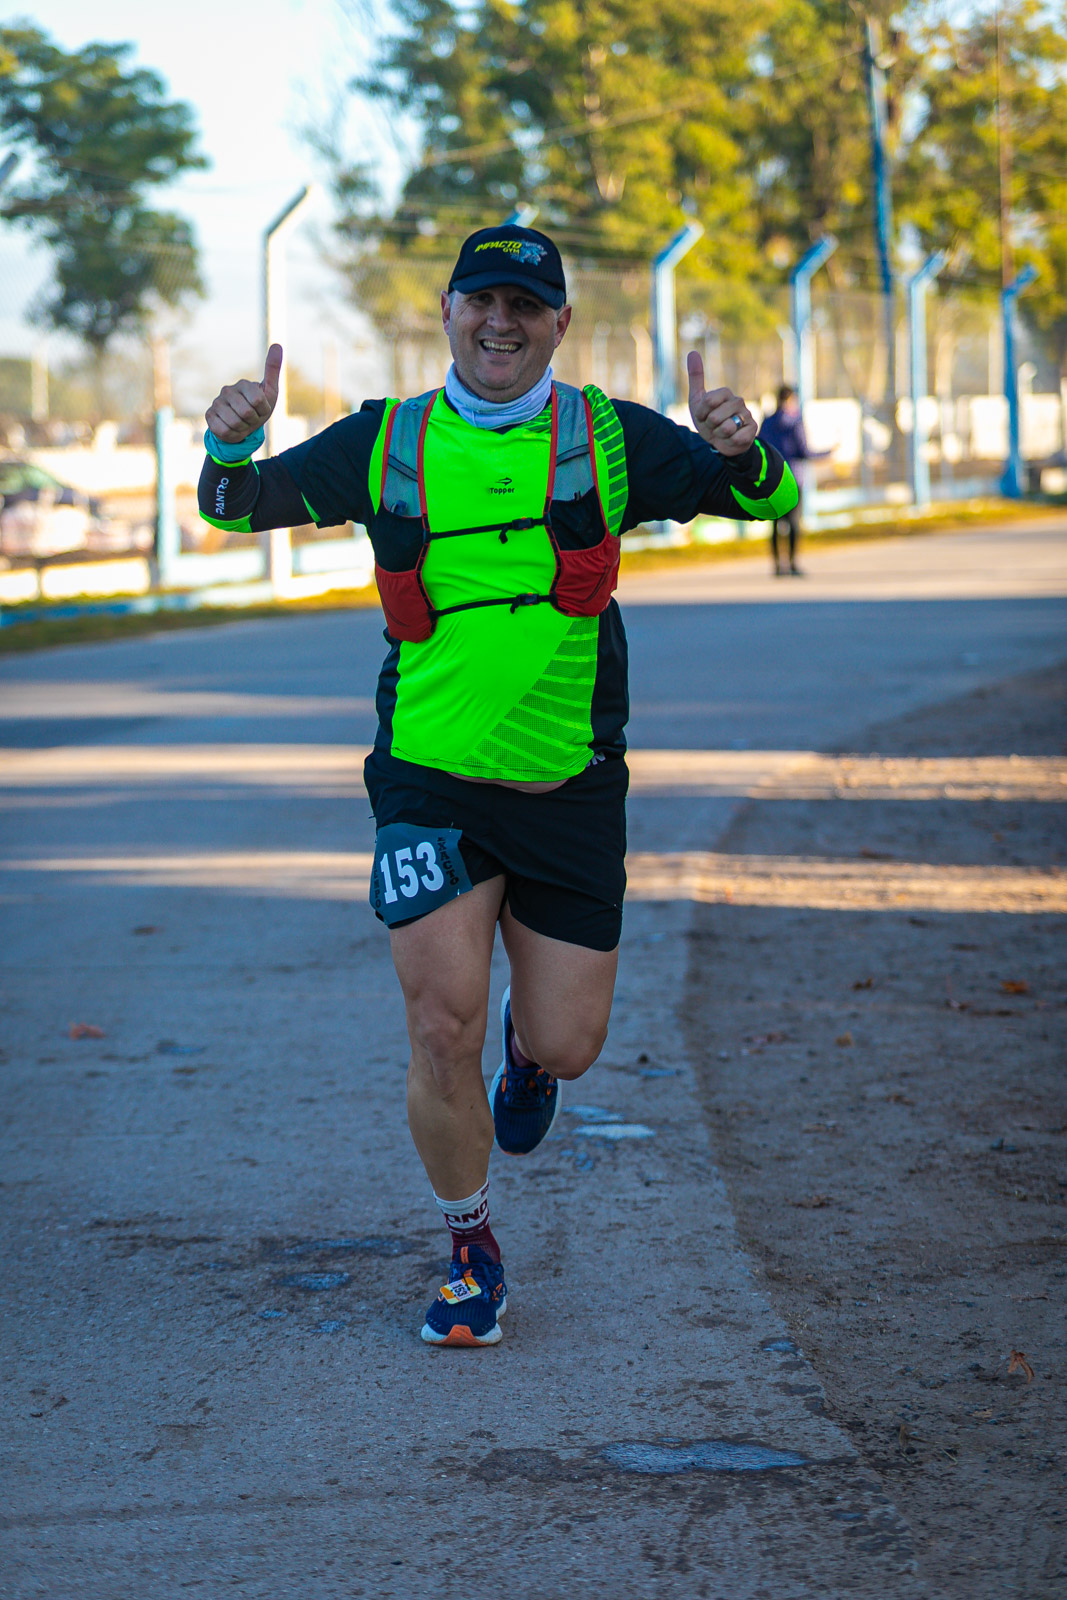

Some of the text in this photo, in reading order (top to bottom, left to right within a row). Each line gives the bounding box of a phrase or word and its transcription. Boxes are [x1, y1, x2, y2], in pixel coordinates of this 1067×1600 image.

[215, 477, 230, 516] PANTRO
[489, 487, 515, 495] Topper
[380, 841, 444, 904] 153
[437, 836, 460, 886] EXACTO
[453, 1284, 468, 1297] 153
